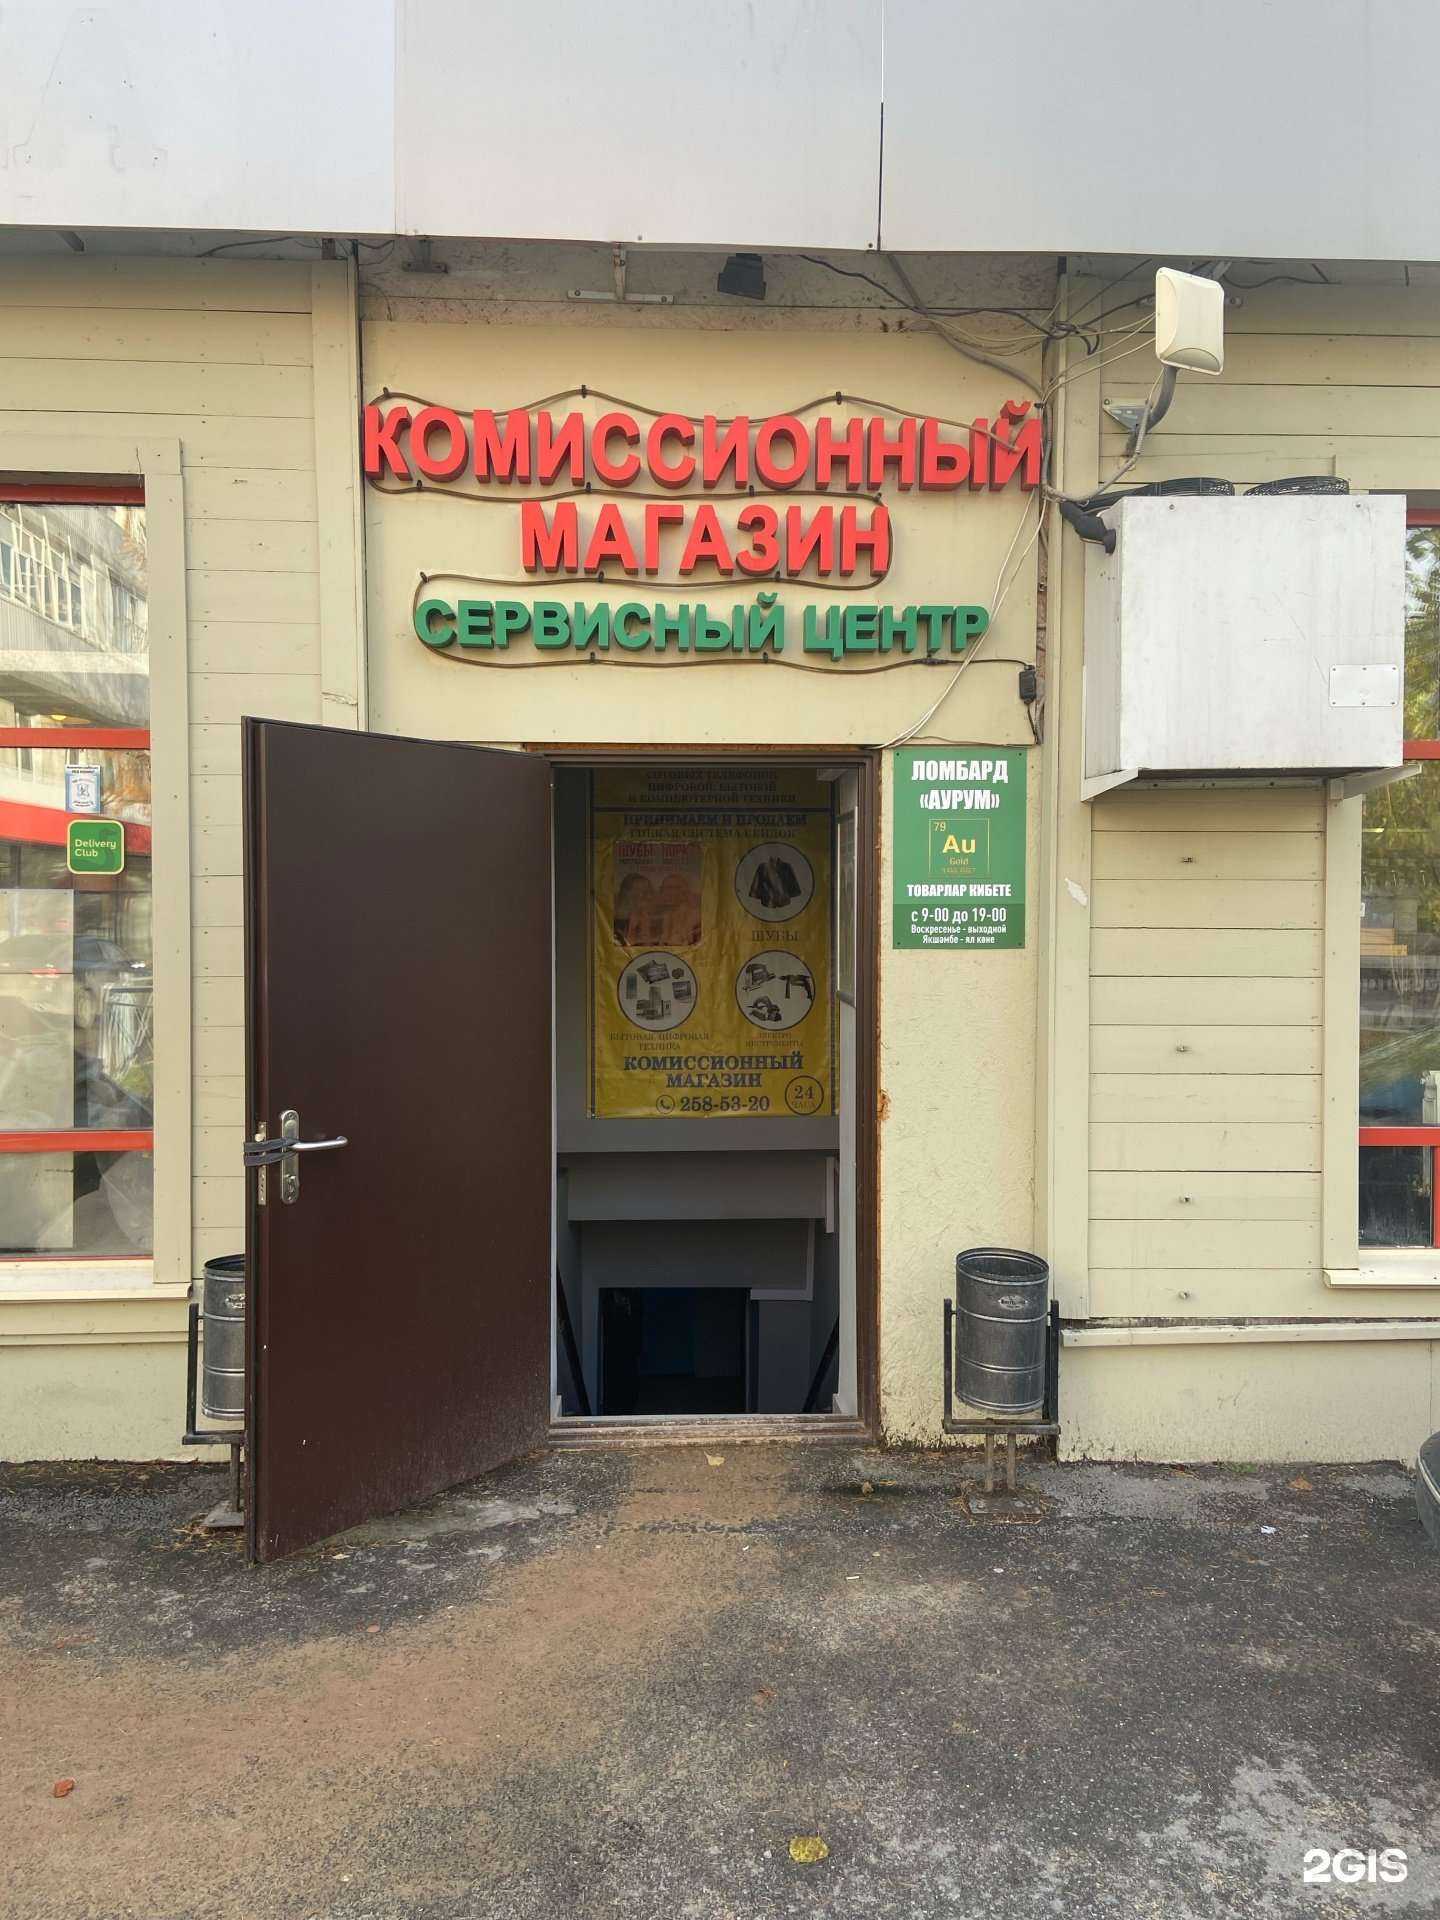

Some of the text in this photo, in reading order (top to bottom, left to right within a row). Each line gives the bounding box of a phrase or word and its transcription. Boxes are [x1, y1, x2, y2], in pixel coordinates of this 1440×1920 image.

[362, 400, 1042, 492] КОМИССИОННЫЙ
[520, 501, 890, 577] МАГАЗИН
[414, 592, 991, 657] СЕРВИСНЫЙ ЦЕНТР
[911, 760, 1009, 783] ЛОМБАРД
[919, 789, 1000, 810] «АУРУМ»
[934, 822, 946, 832] 79
[75, 840, 117, 850] Delivery
[942, 834, 976, 854] Au
[75, 848, 98, 857] Club
[907, 884, 1012, 897] ТОВАРЛАР КИБЕТЕ
[911, 908, 1007, 924] с 9-00 до 19-00
[911, 924, 961, 935] Воскресенье
[968, 923, 1007, 934] выходной
[624, 1051, 804, 1071] КОМИССИОННЫЙ
[665, 1073, 762, 1088] МАГАЗИН
[794, 1086, 814, 1099] 24
[680, 1096, 770, 1112] 258-53-20
